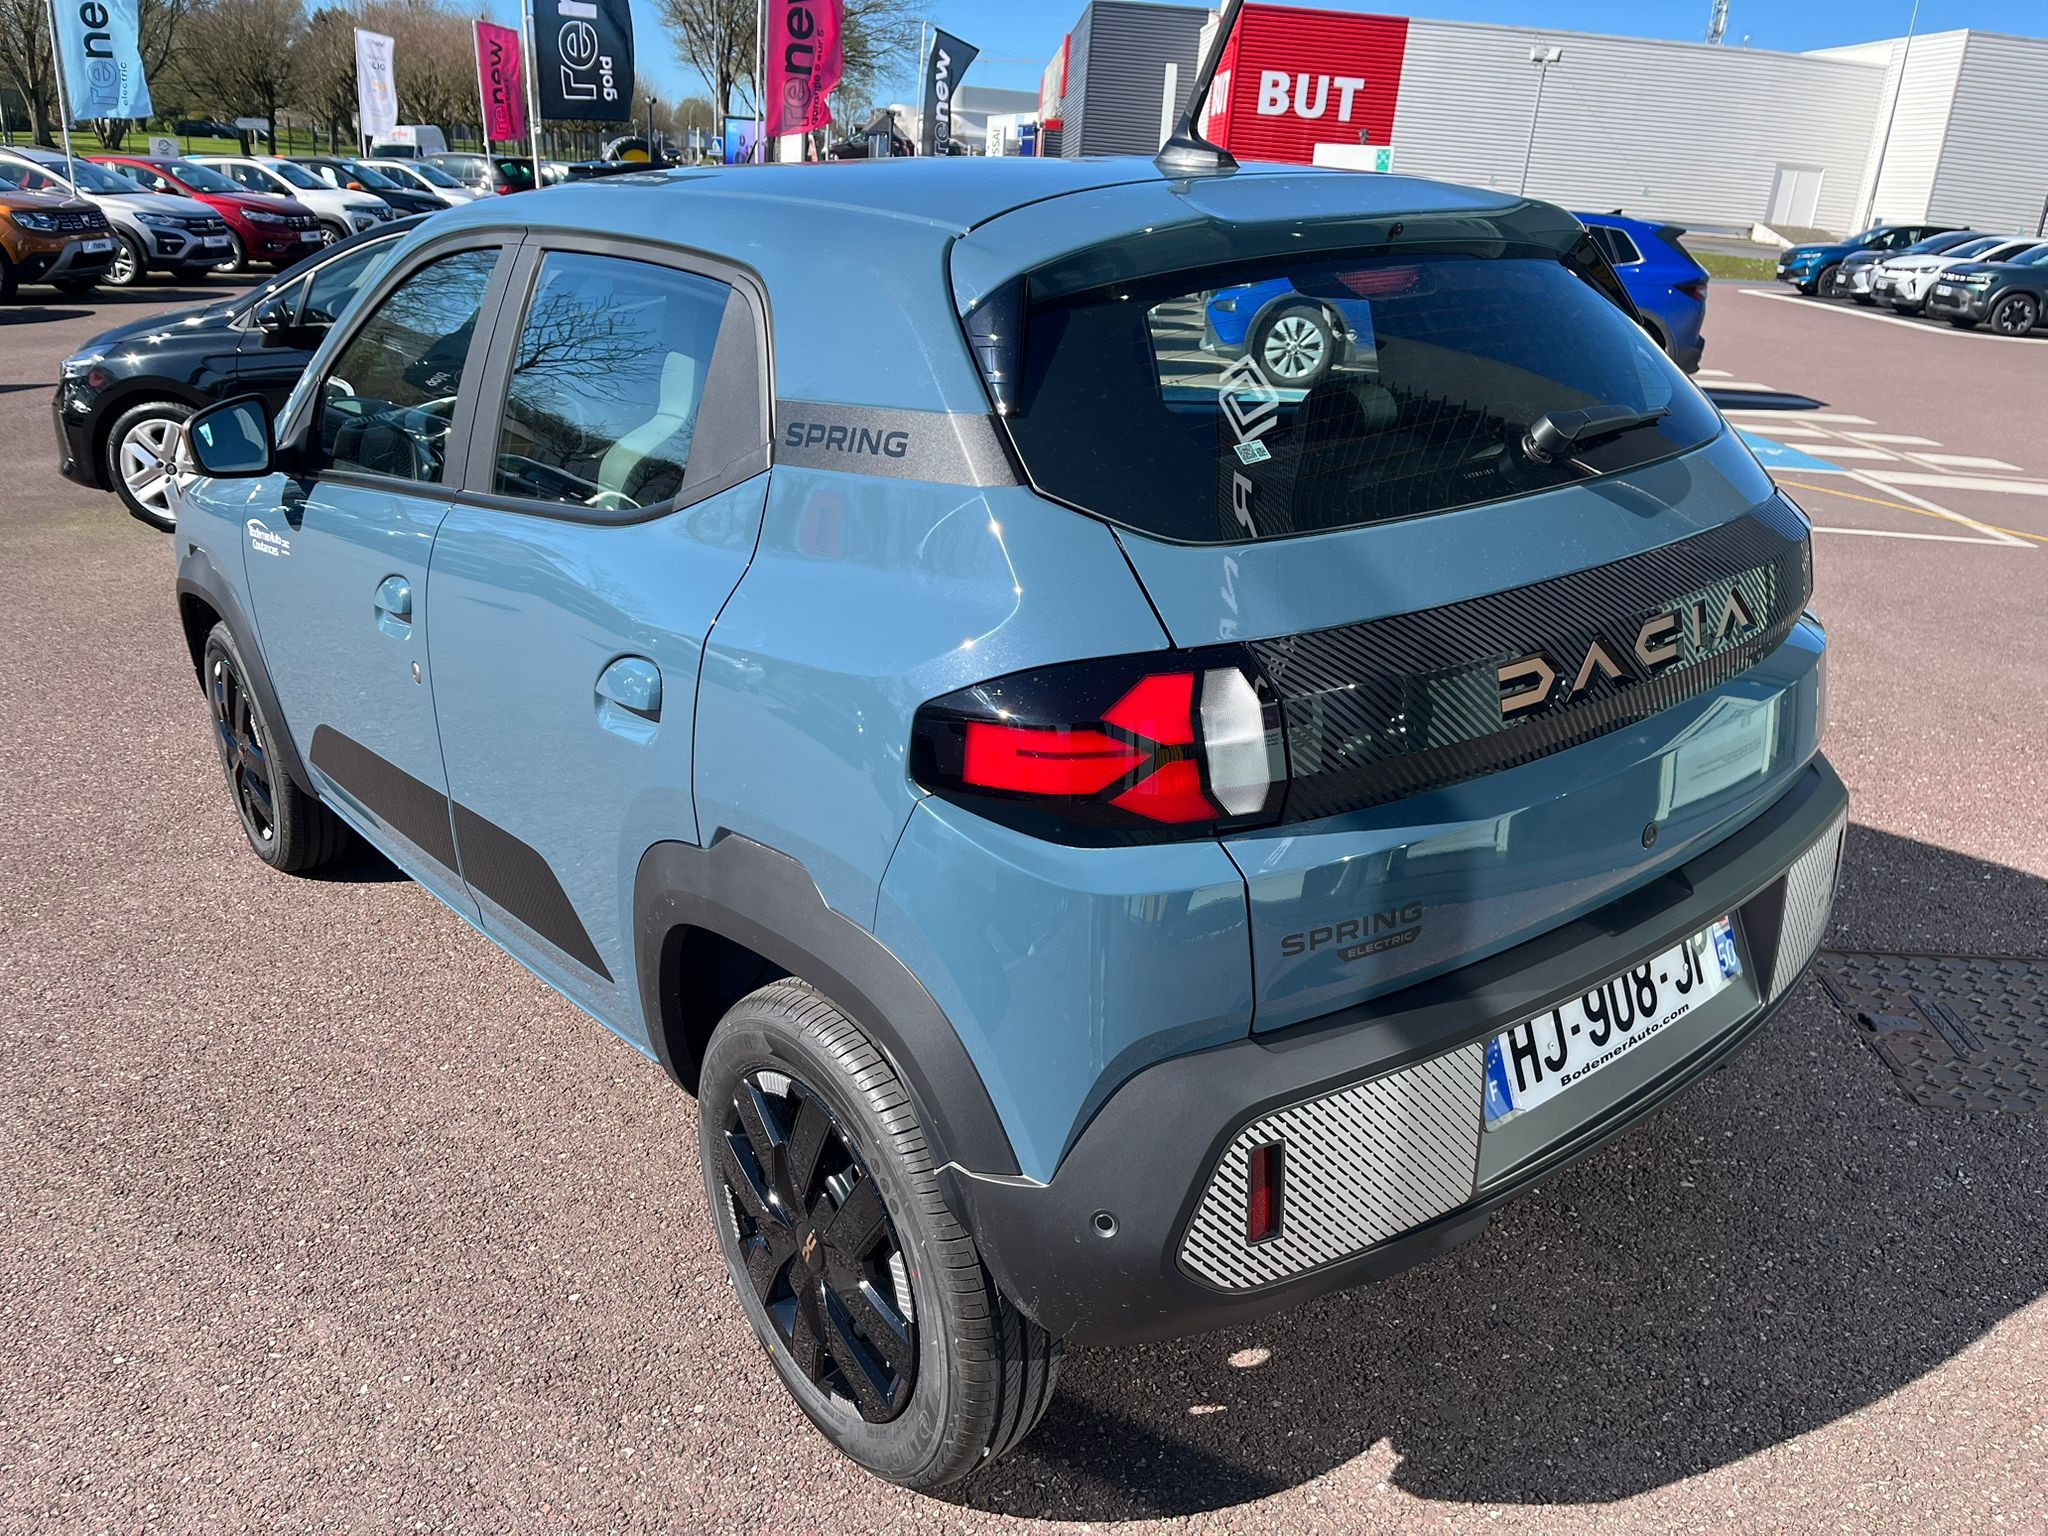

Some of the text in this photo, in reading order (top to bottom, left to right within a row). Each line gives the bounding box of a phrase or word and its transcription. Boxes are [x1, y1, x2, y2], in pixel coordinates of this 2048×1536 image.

[120, 62, 129, 106] electric
[489, 39, 507, 135] renew
[599, 56, 618, 102] gold
[783, 0, 815, 127] rene
[934, 48, 951, 156] renew
[1256, 69, 1365, 123] BUT
[991, 129, 1001, 156] SSAI
[785, 422, 910, 458] SPRING
[1497, 584, 1758, 716] DACIA
[1281, 900, 1423, 957] SPRING
[1347, 932, 1413, 958] ELECTRIC
[1716, 938, 1737, 972] 50
[1560, 1003, 1690, 1087] BodemerAuto.com
[1489, 1079, 1498, 1102] F
